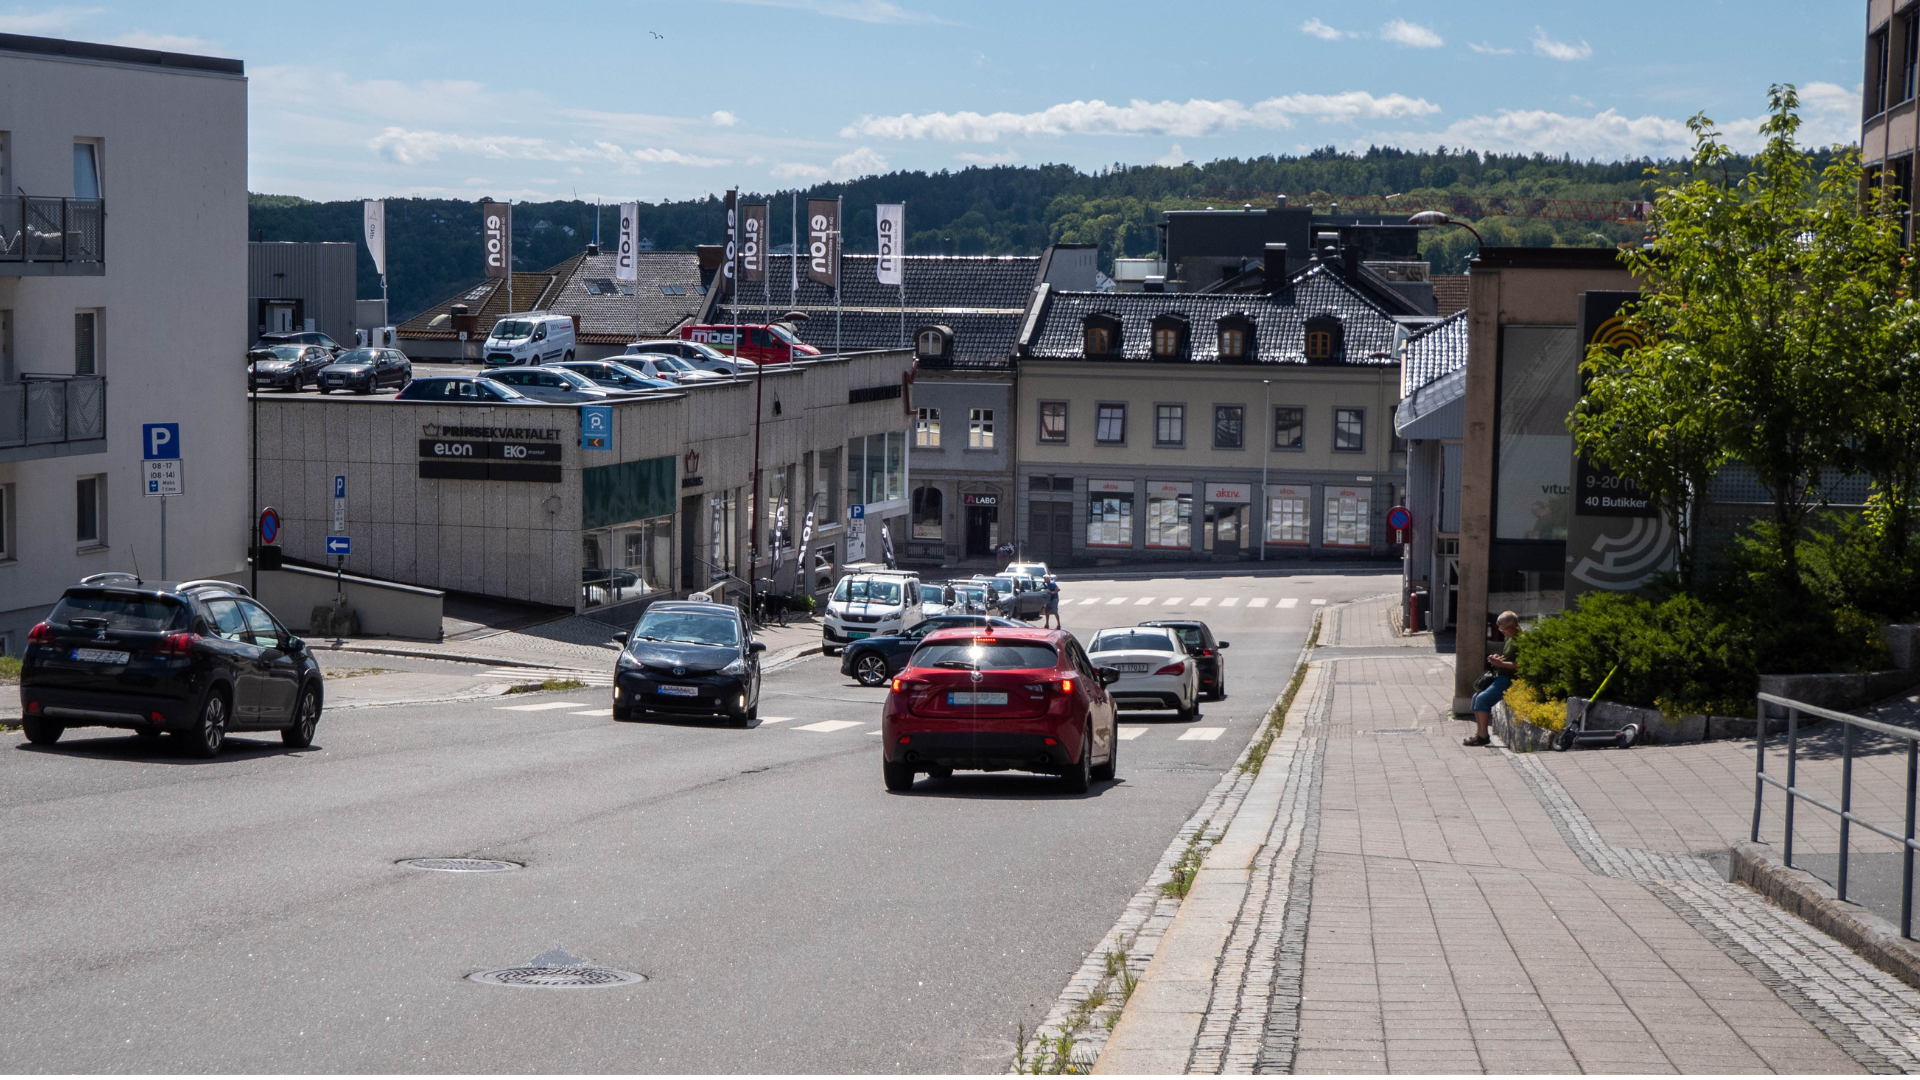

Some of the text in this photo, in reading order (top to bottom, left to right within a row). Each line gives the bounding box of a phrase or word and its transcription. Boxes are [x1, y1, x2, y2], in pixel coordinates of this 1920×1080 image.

[442, 425, 562, 440] PRINSEKVARTALET
[151, 427, 171, 455] P
[503, 445, 527, 458] EKO
[337, 477, 343, 496] P
[1586, 475, 1620, 489] 9-20
[975, 496, 996, 504] LABO
[1585, 496, 1648, 508] 40 Butikker
[853, 506, 862, 517] P
